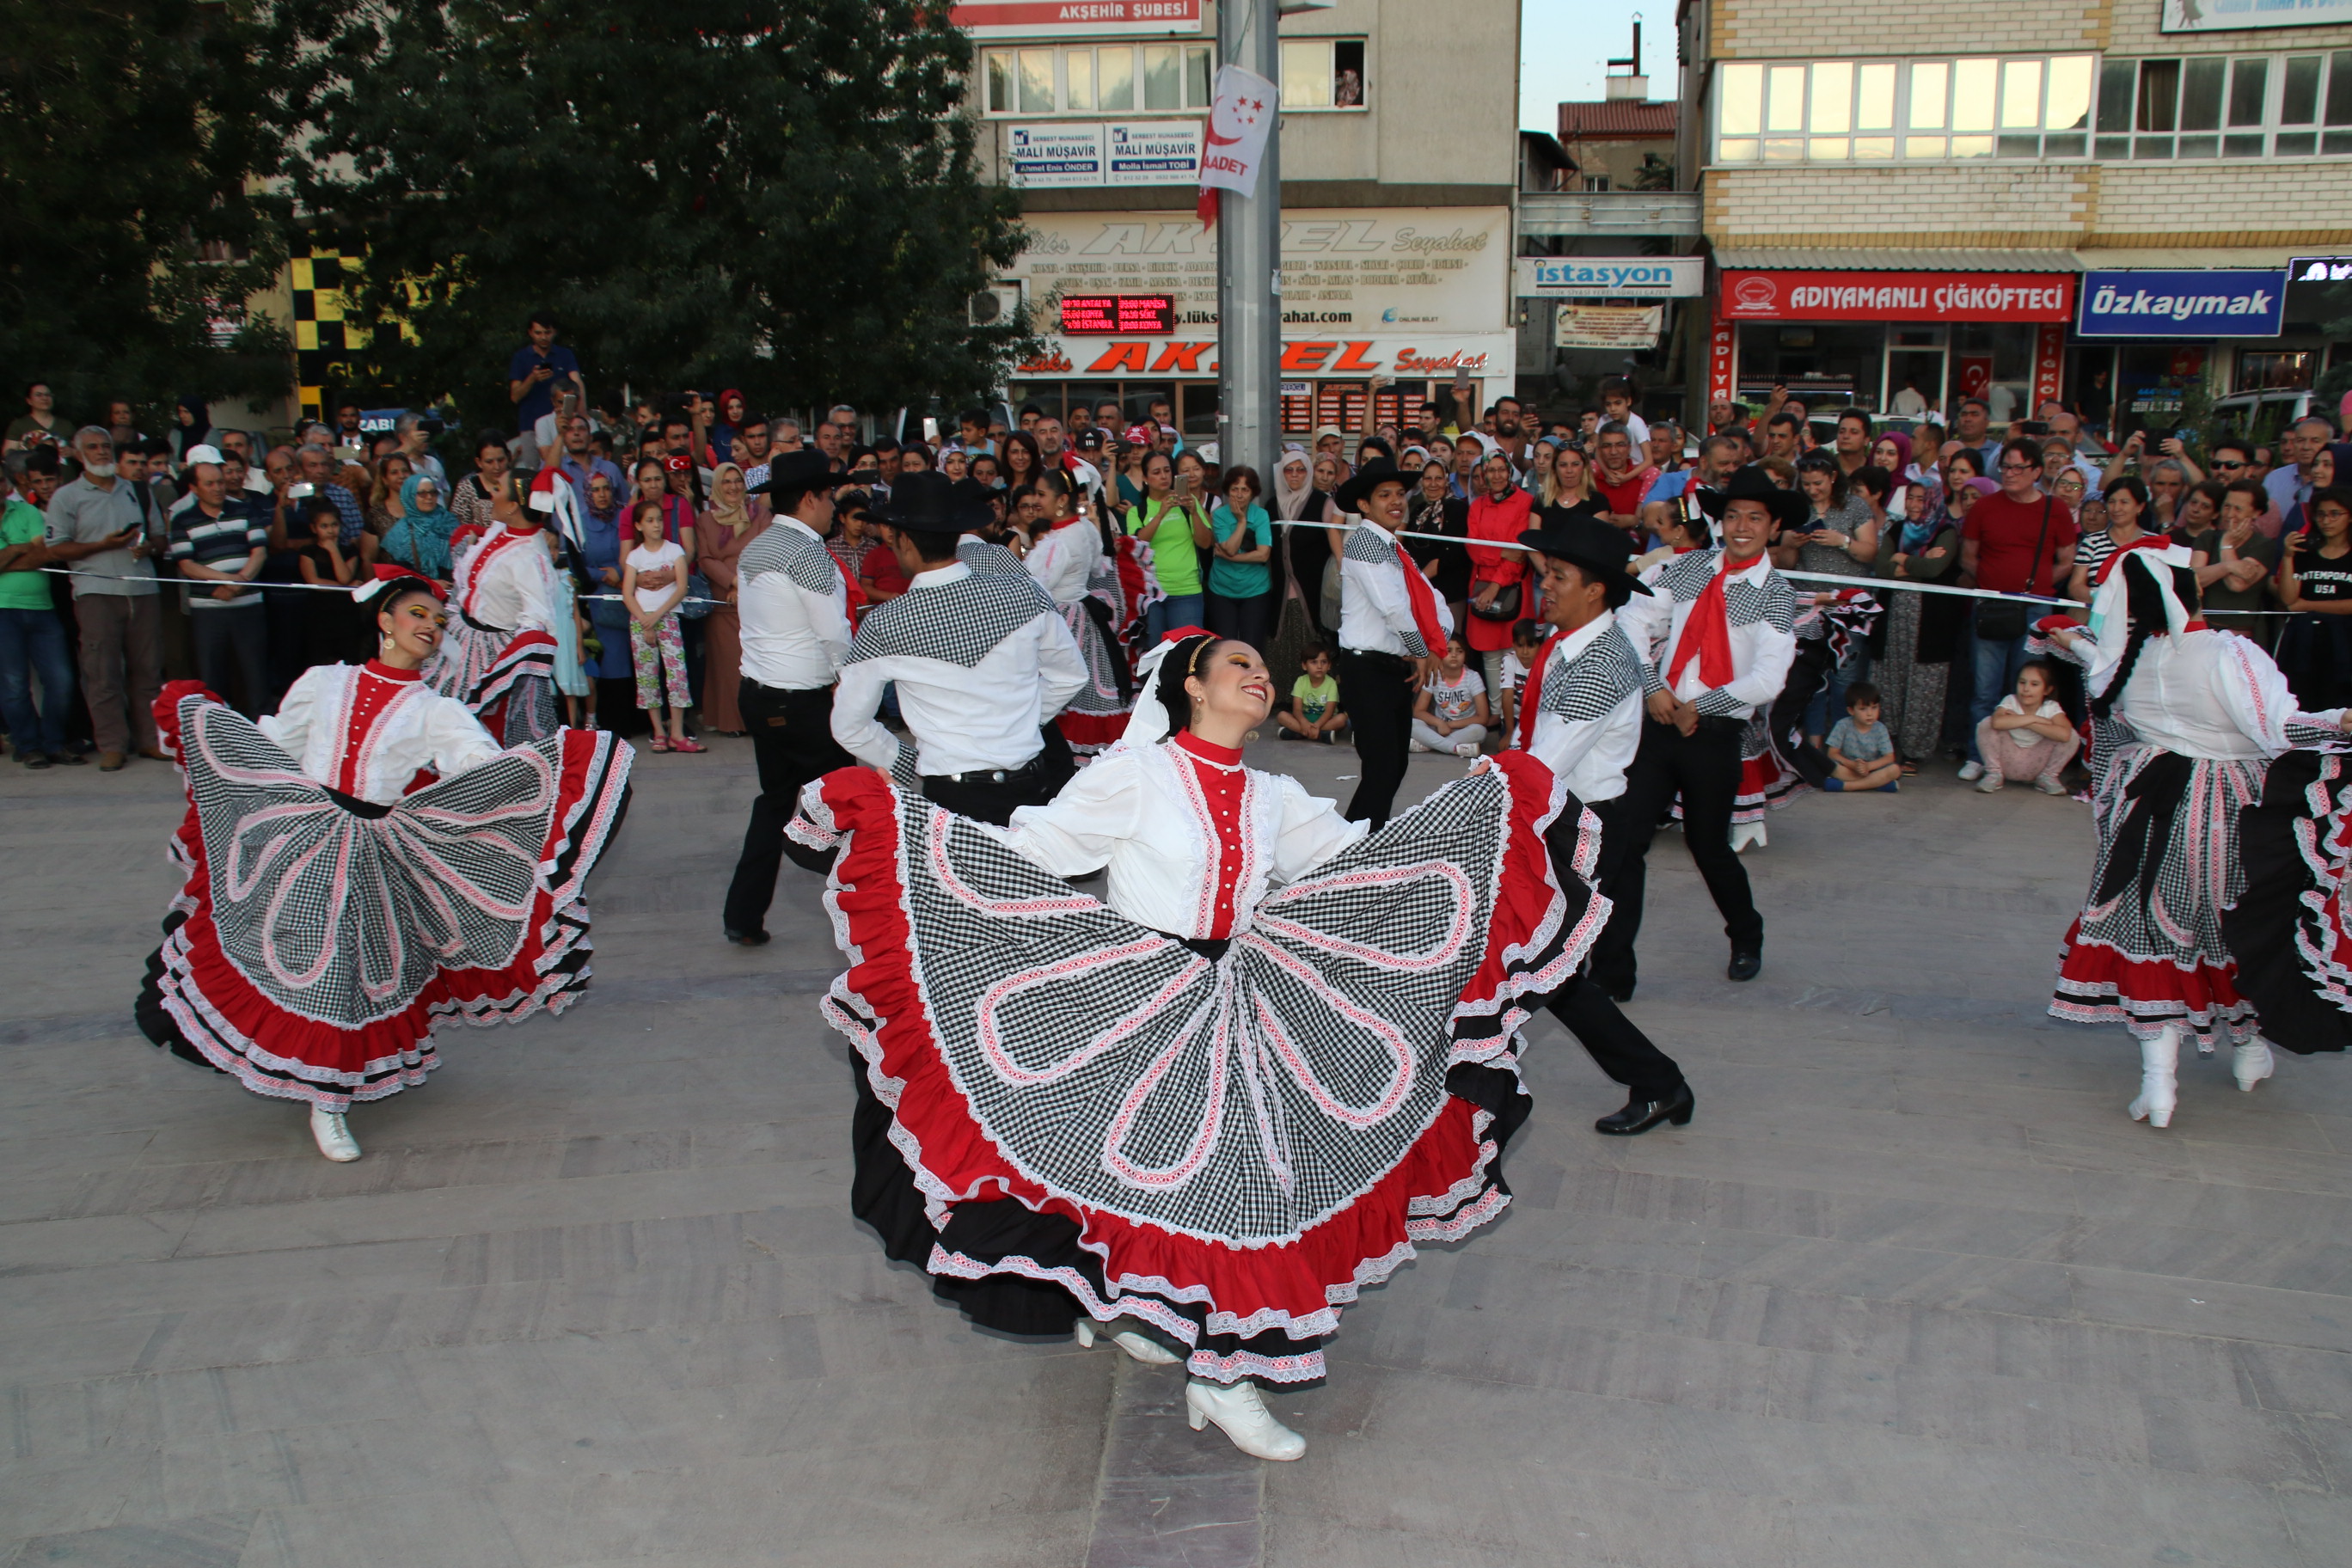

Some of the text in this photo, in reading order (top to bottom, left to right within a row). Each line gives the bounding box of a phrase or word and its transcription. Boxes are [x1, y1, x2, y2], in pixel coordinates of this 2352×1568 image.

[1059, 1, 1188, 20] AKŞEHİR ŞUBESİ
[1016, 143, 1096, 159] MALİ MÜŞAVİR
[1116, 140, 1196, 157] MALİ MÜŞAVİR
[1020, 163, 1044, 172] Ahmet
[1064, 162, 1093, 171] ÖNDER
[1119, 160, 1190, 170] Molla İsmail TOBİ
[1204, 154, 1248, 176] AADET
[1392, 227, 1489, 257] Seyahat
[1113, 262, 1141, 273] BURSA
[1534, 260, 1673, 288] istasyon
[1090, 278, 1112, 290] UŞAK
[1298, 273, 1320, 285] SÖKE
[1361, 274, 1400, 285] BODRUM
[1406, 273, 1437, 285] MUĞLA
[1317, 290, 1353, 301] ANKARA
[1791, 285, 1926, 310] ADIYAMANLI
[1934, 283, 2064, 313] ÇİĞKÖFTECİ
[2091, 285, 2274, 321] Özkaymak
[1084, 340, 1382, 372] AKEL
[1393, 347, 1490, 374] Seyahat
[2314, 585, 2337, 593] USA
[1437, 690, 1466, 703] SHINE
